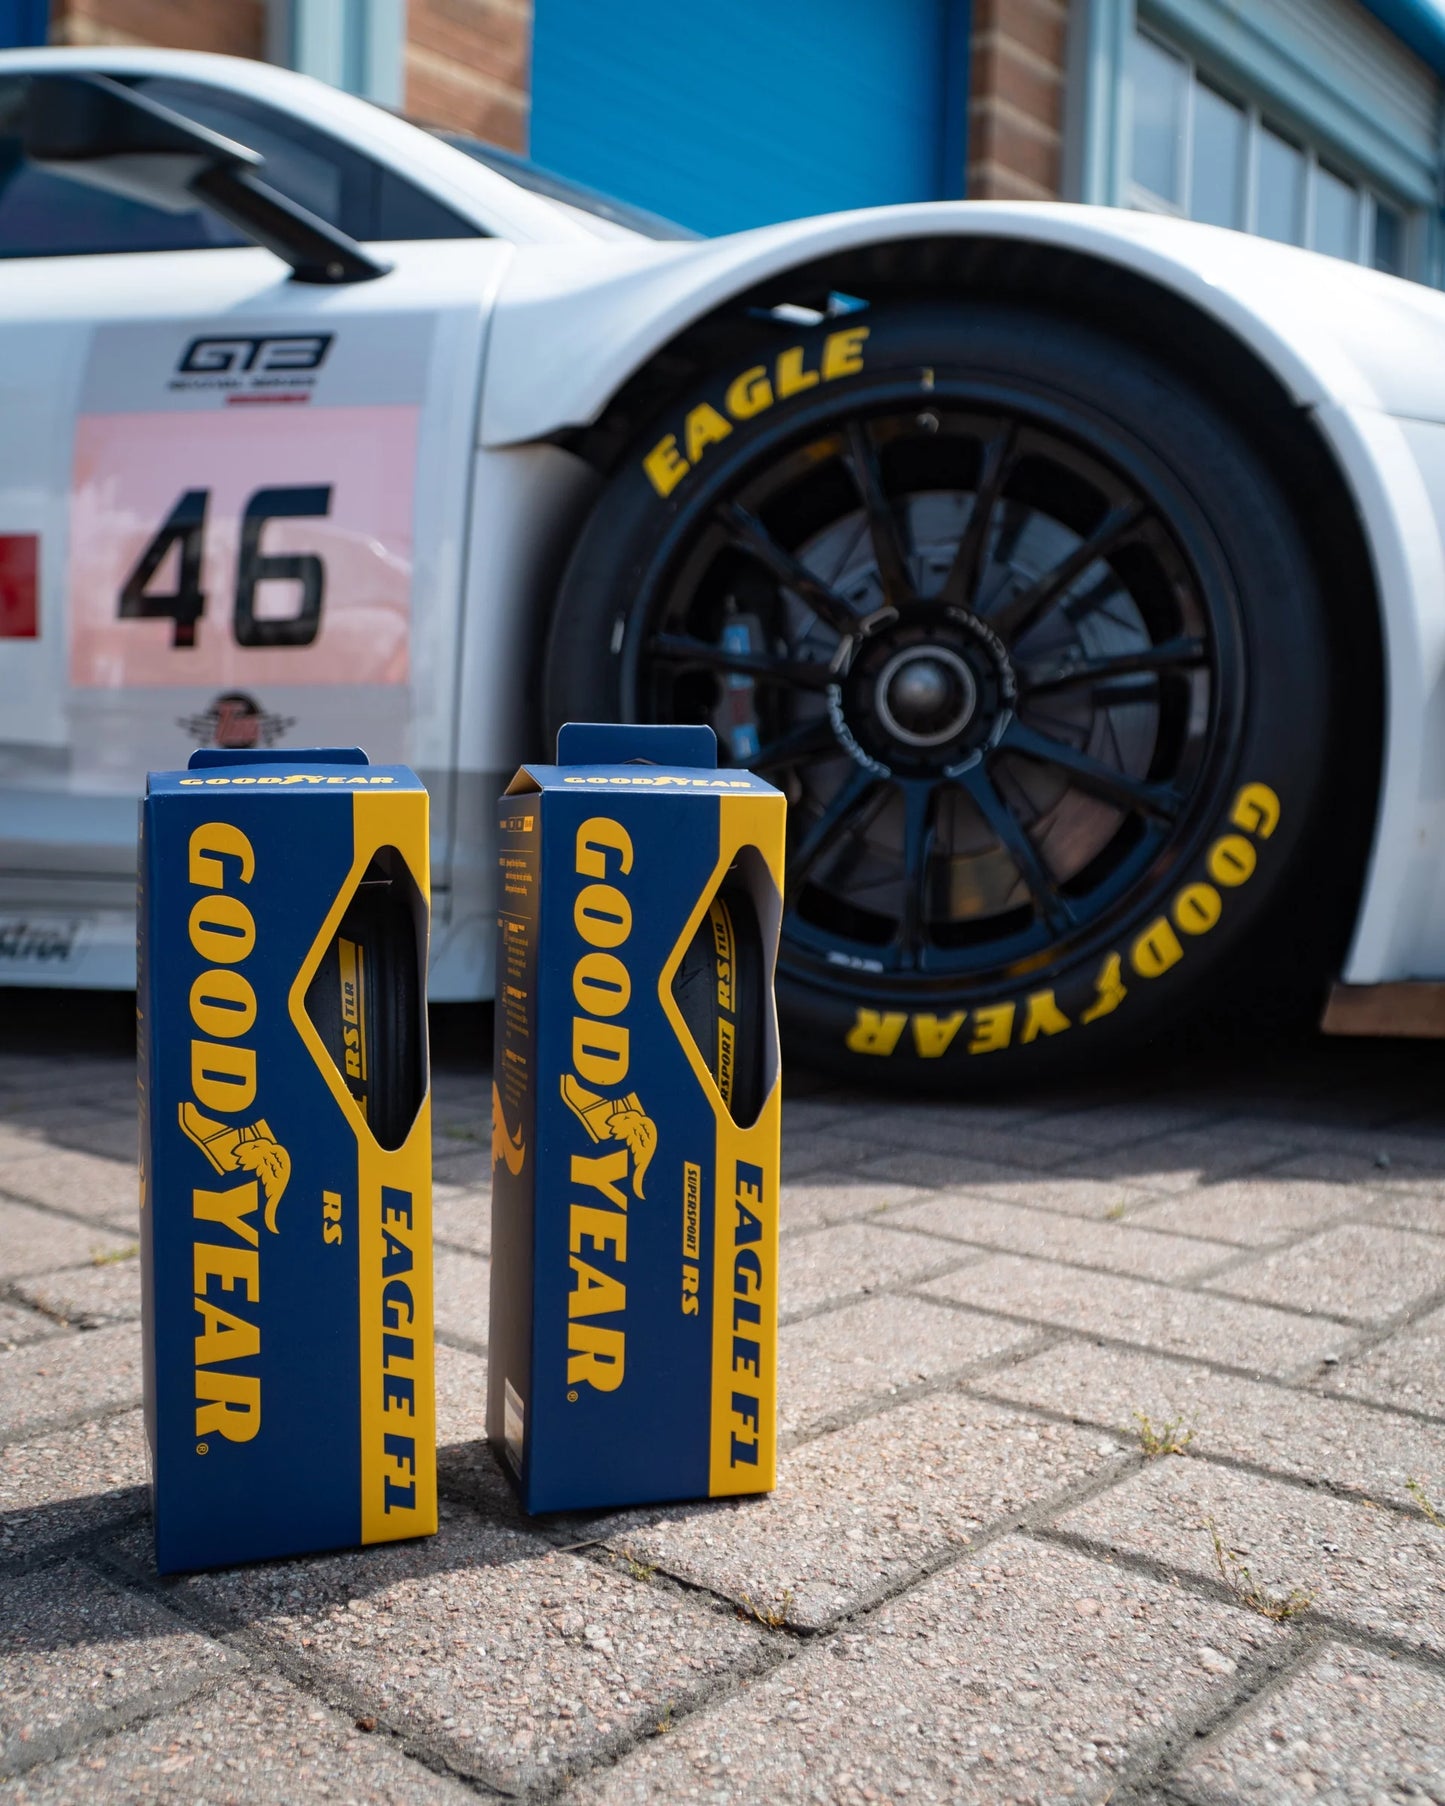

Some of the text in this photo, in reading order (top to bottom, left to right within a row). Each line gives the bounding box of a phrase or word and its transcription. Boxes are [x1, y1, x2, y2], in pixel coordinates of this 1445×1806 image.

[177, 333, 335, 373] GT3
[643, 326, 871, 498] EAGLE
[117, 482, 334, 650] 46
[179, 774, 396, 785] GOODYEAR
[563, 776, 753, 788] GOODYEAR
[716, 921, 728, 952] TLR
[716, 957, 731, 1010] RS
[846, 781, 1281, 1058] GOODYEAR
[343, 981, 361, 1080] RS TLR
[567, 816, 634, 1393] GOODYEAR
[187, 822, 262, 1444] GOODYEAR
[322, 1190, 343, 1246] RS
[681, 1166, 700, 1317] SUPERSPORT RS
[381, 1184, 416, 1515] EAGLE F1
[730, 1158, 763, 1470] EAGLE F1
